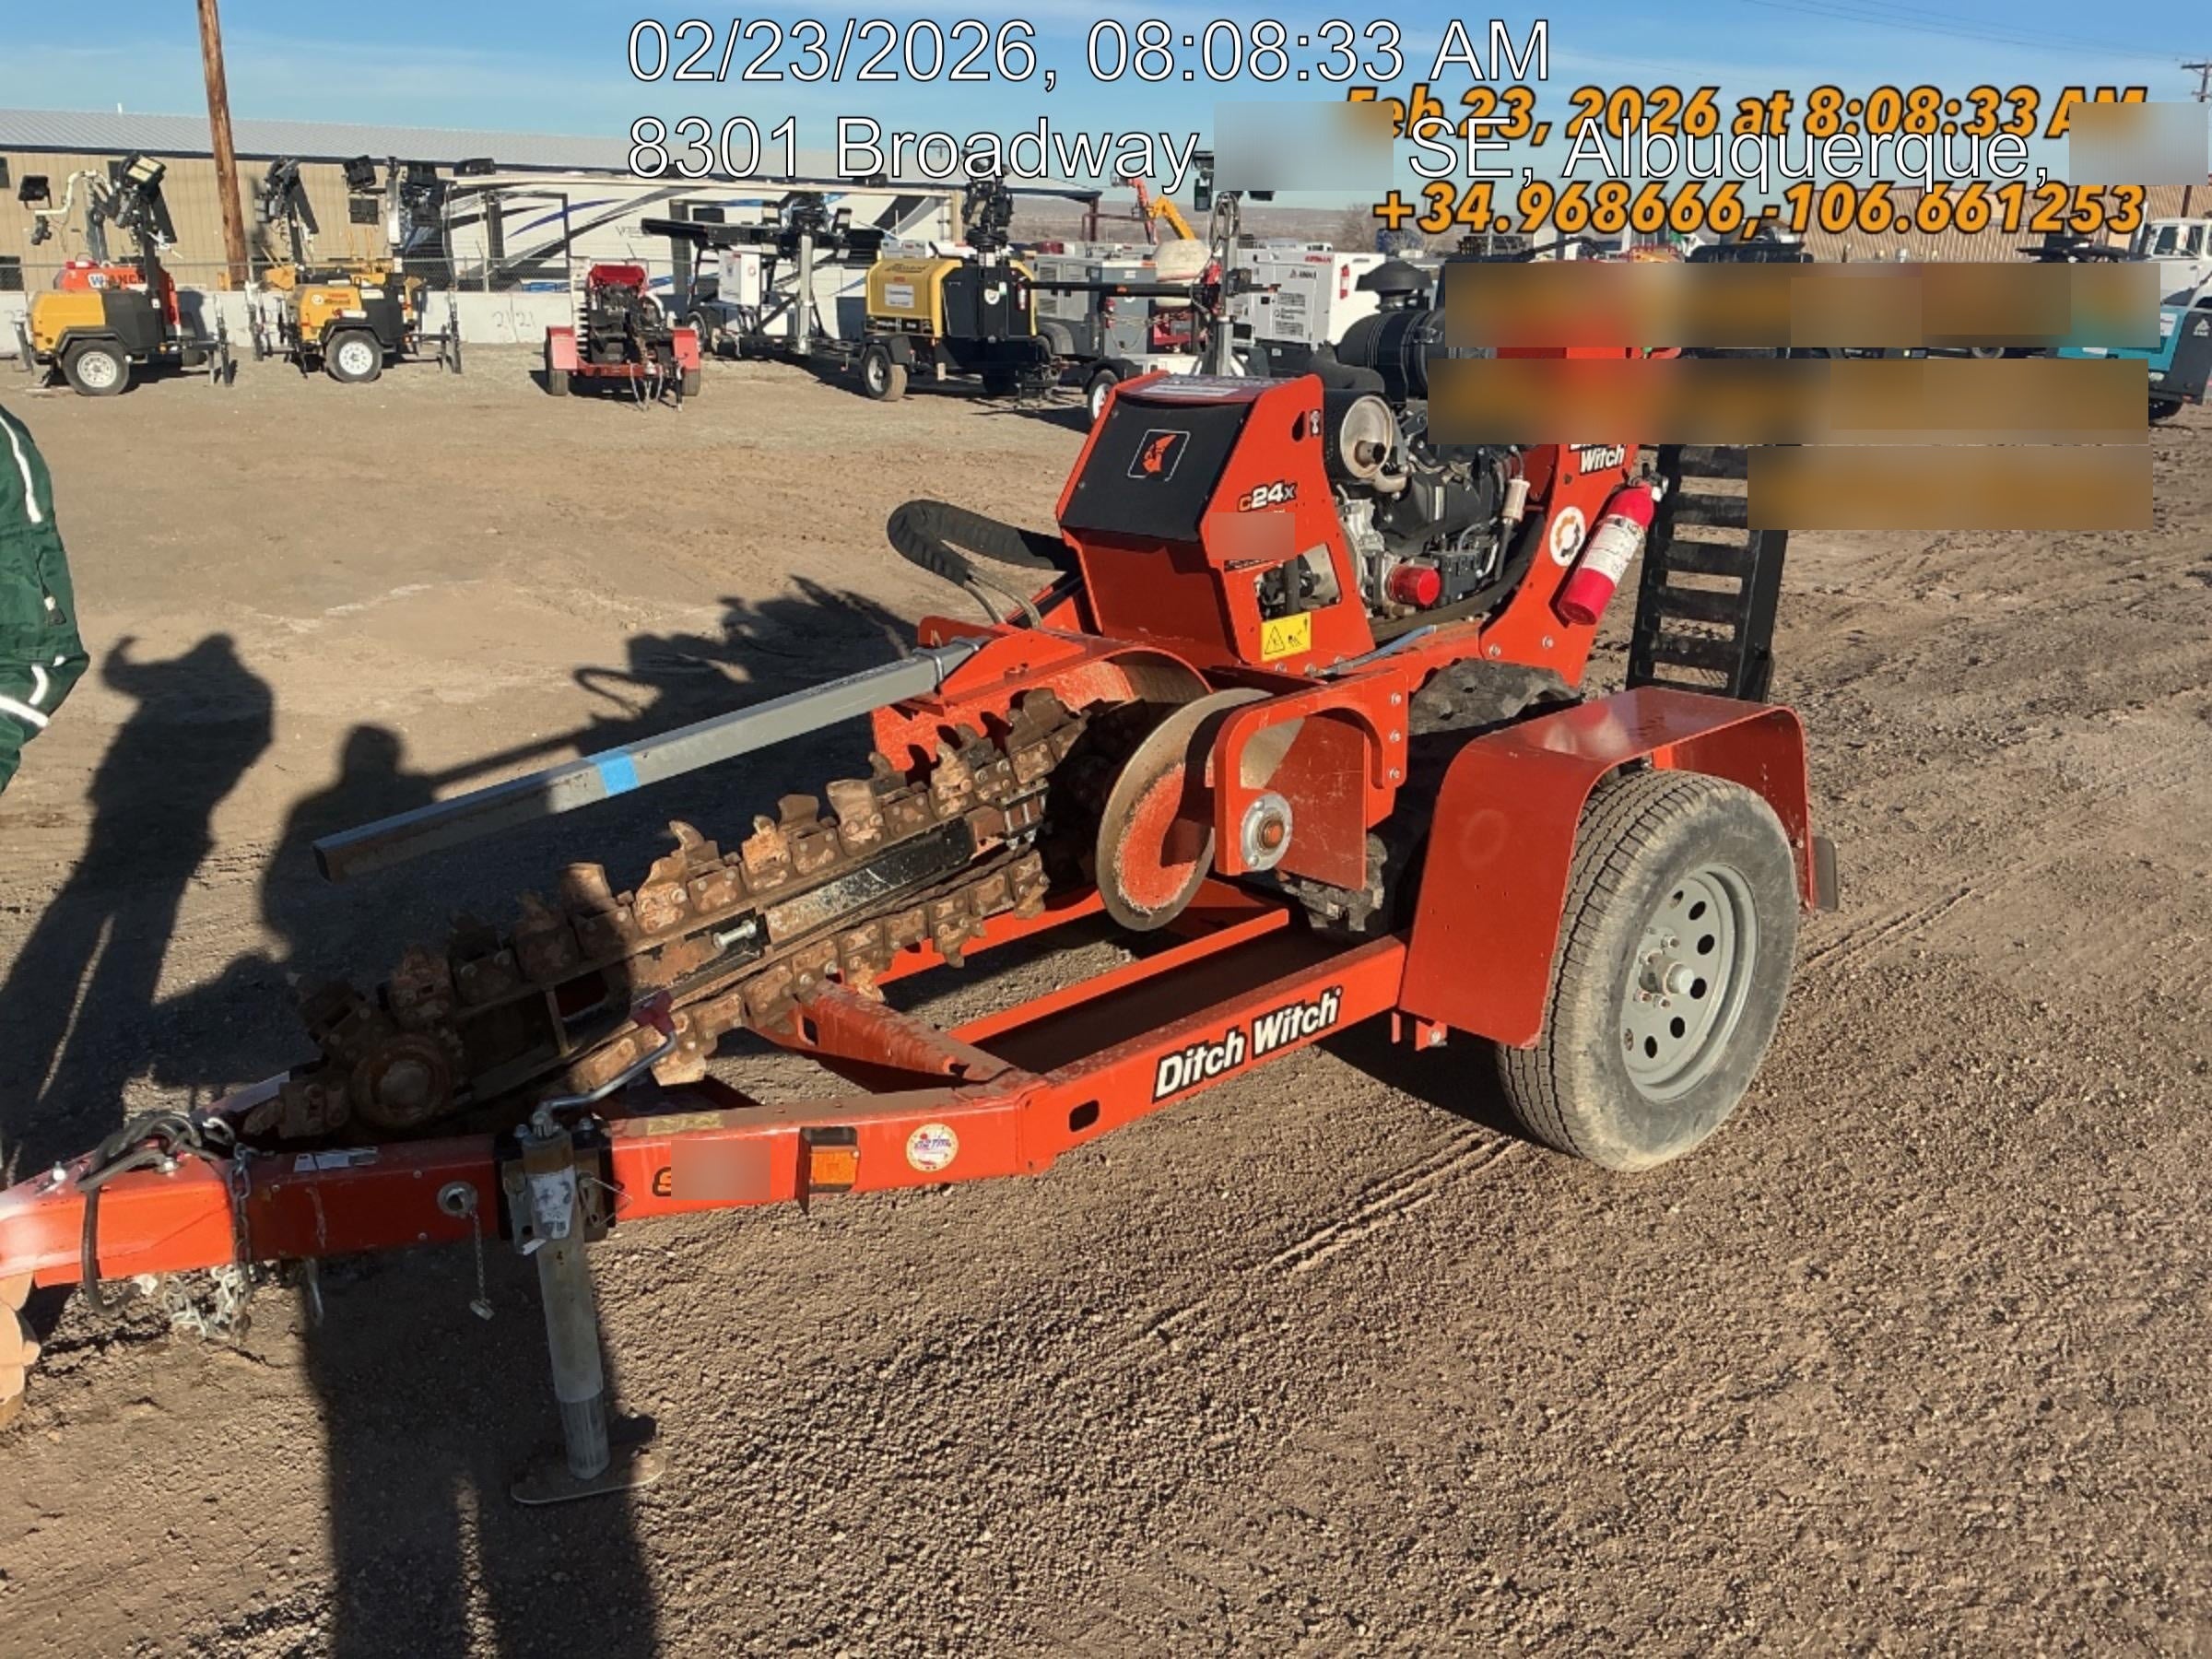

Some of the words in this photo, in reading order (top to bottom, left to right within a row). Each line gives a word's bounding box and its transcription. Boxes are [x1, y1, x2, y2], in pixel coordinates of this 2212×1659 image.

[1580, 443, 1625, 475] Witch
[1153, 1025, 1247, 1102] Ditch
[1252, 987, 1342, 1057] Witch
